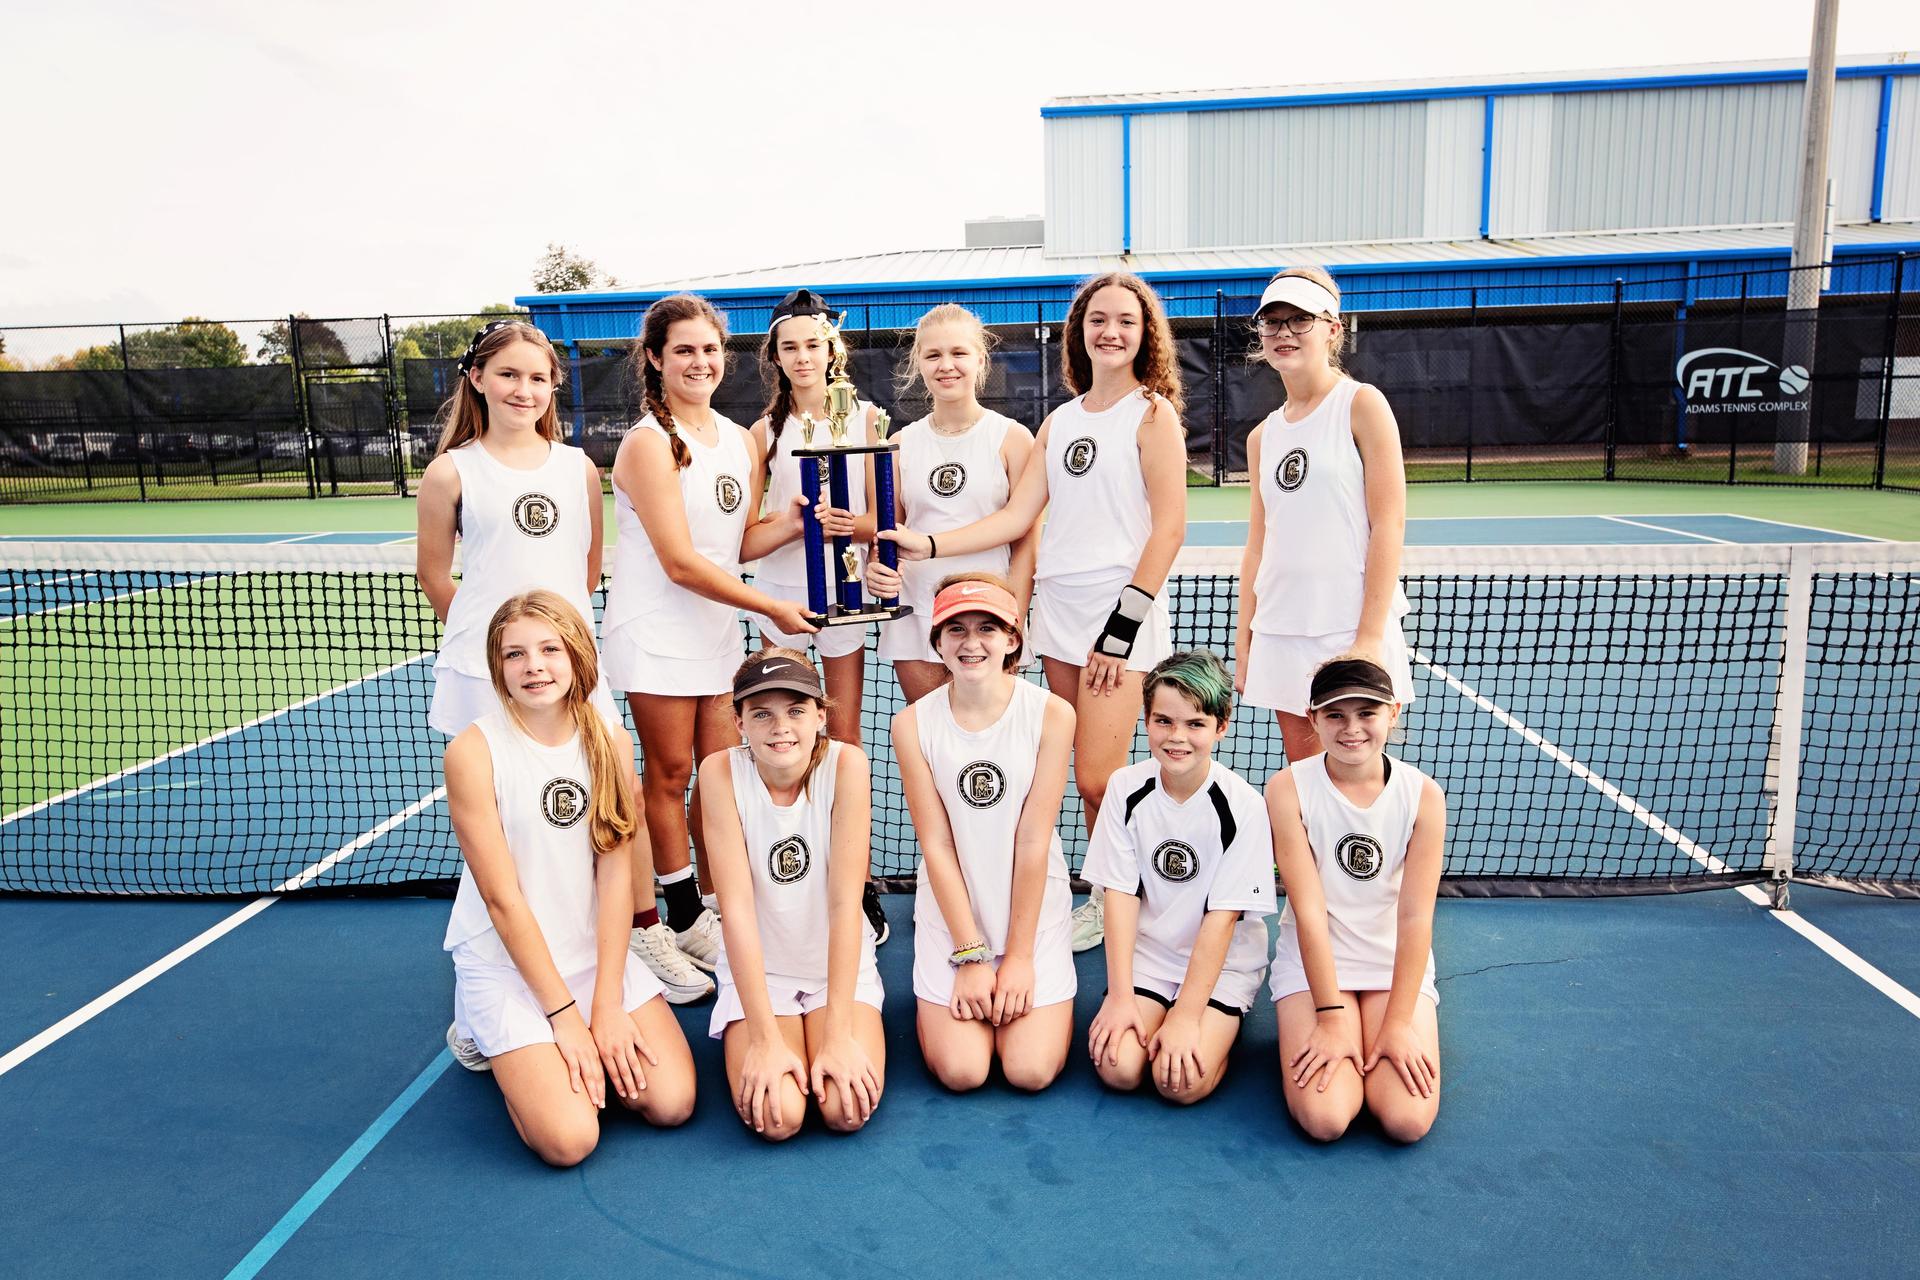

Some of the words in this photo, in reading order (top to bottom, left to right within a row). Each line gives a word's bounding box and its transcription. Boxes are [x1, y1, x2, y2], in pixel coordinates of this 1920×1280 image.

[1687, 365, 1769, 399] ATC
[1685, 403, 1720, 414] ADAMS
[1721, 402, 1756, 413] TENNIS
[1758, 401, 1808, 412] COMPLEX
